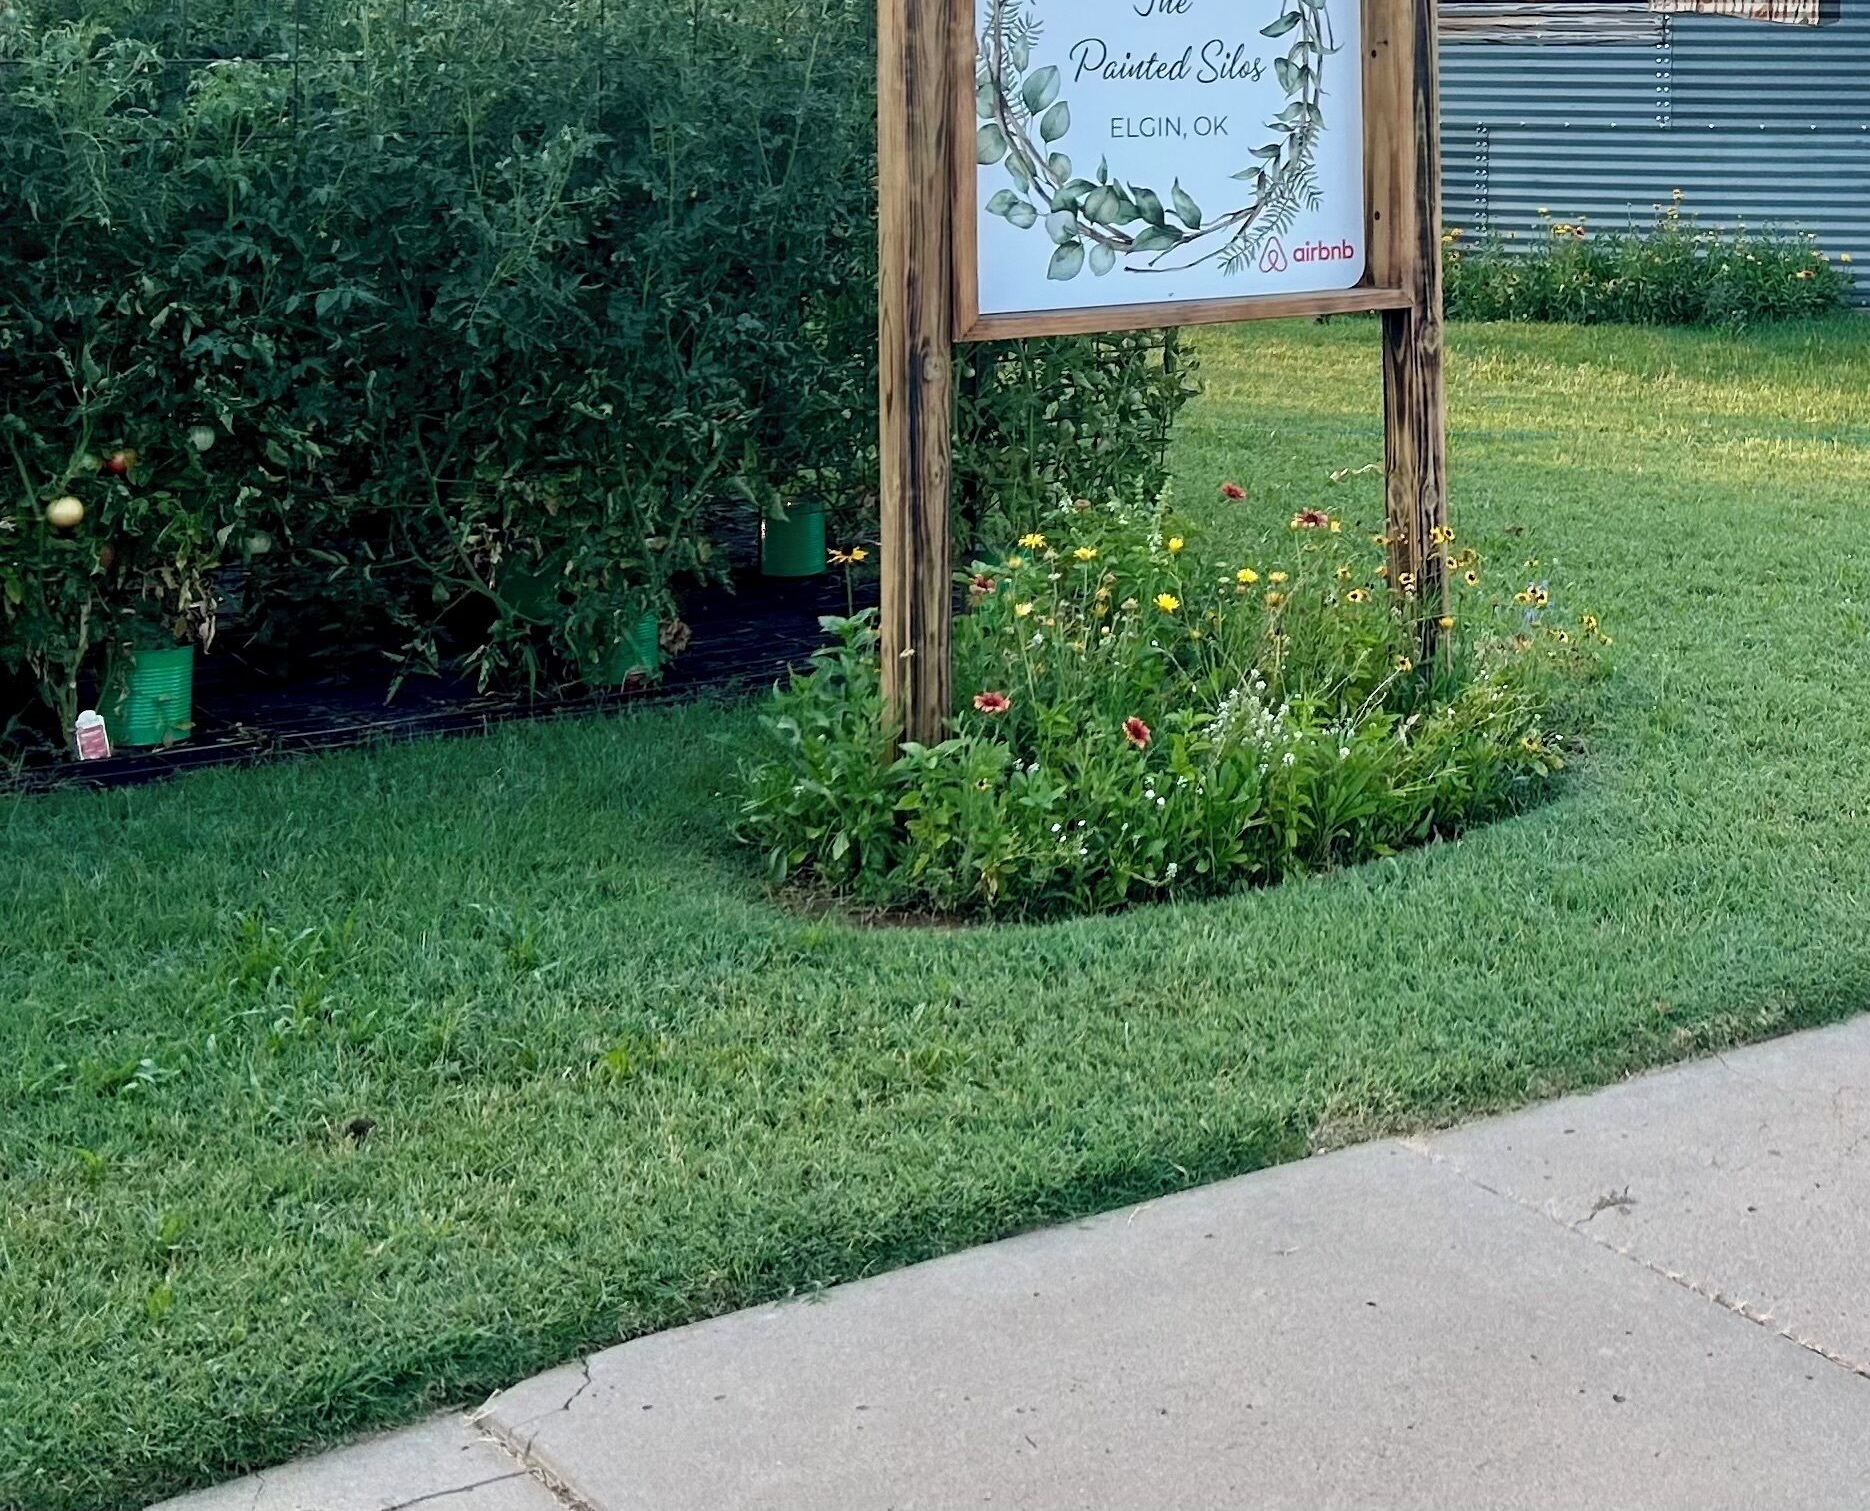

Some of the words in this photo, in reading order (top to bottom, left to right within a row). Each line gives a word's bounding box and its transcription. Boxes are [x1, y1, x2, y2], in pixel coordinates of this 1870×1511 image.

[1069, 37, 1192, 83] Painted
[1196, 39, 1267, 84] Silos
[1110, 115, 1187, 140] ELGIN,
[1193, 115, 1228, 137] OK
[1292, 239, 1354, 263] airbnb
